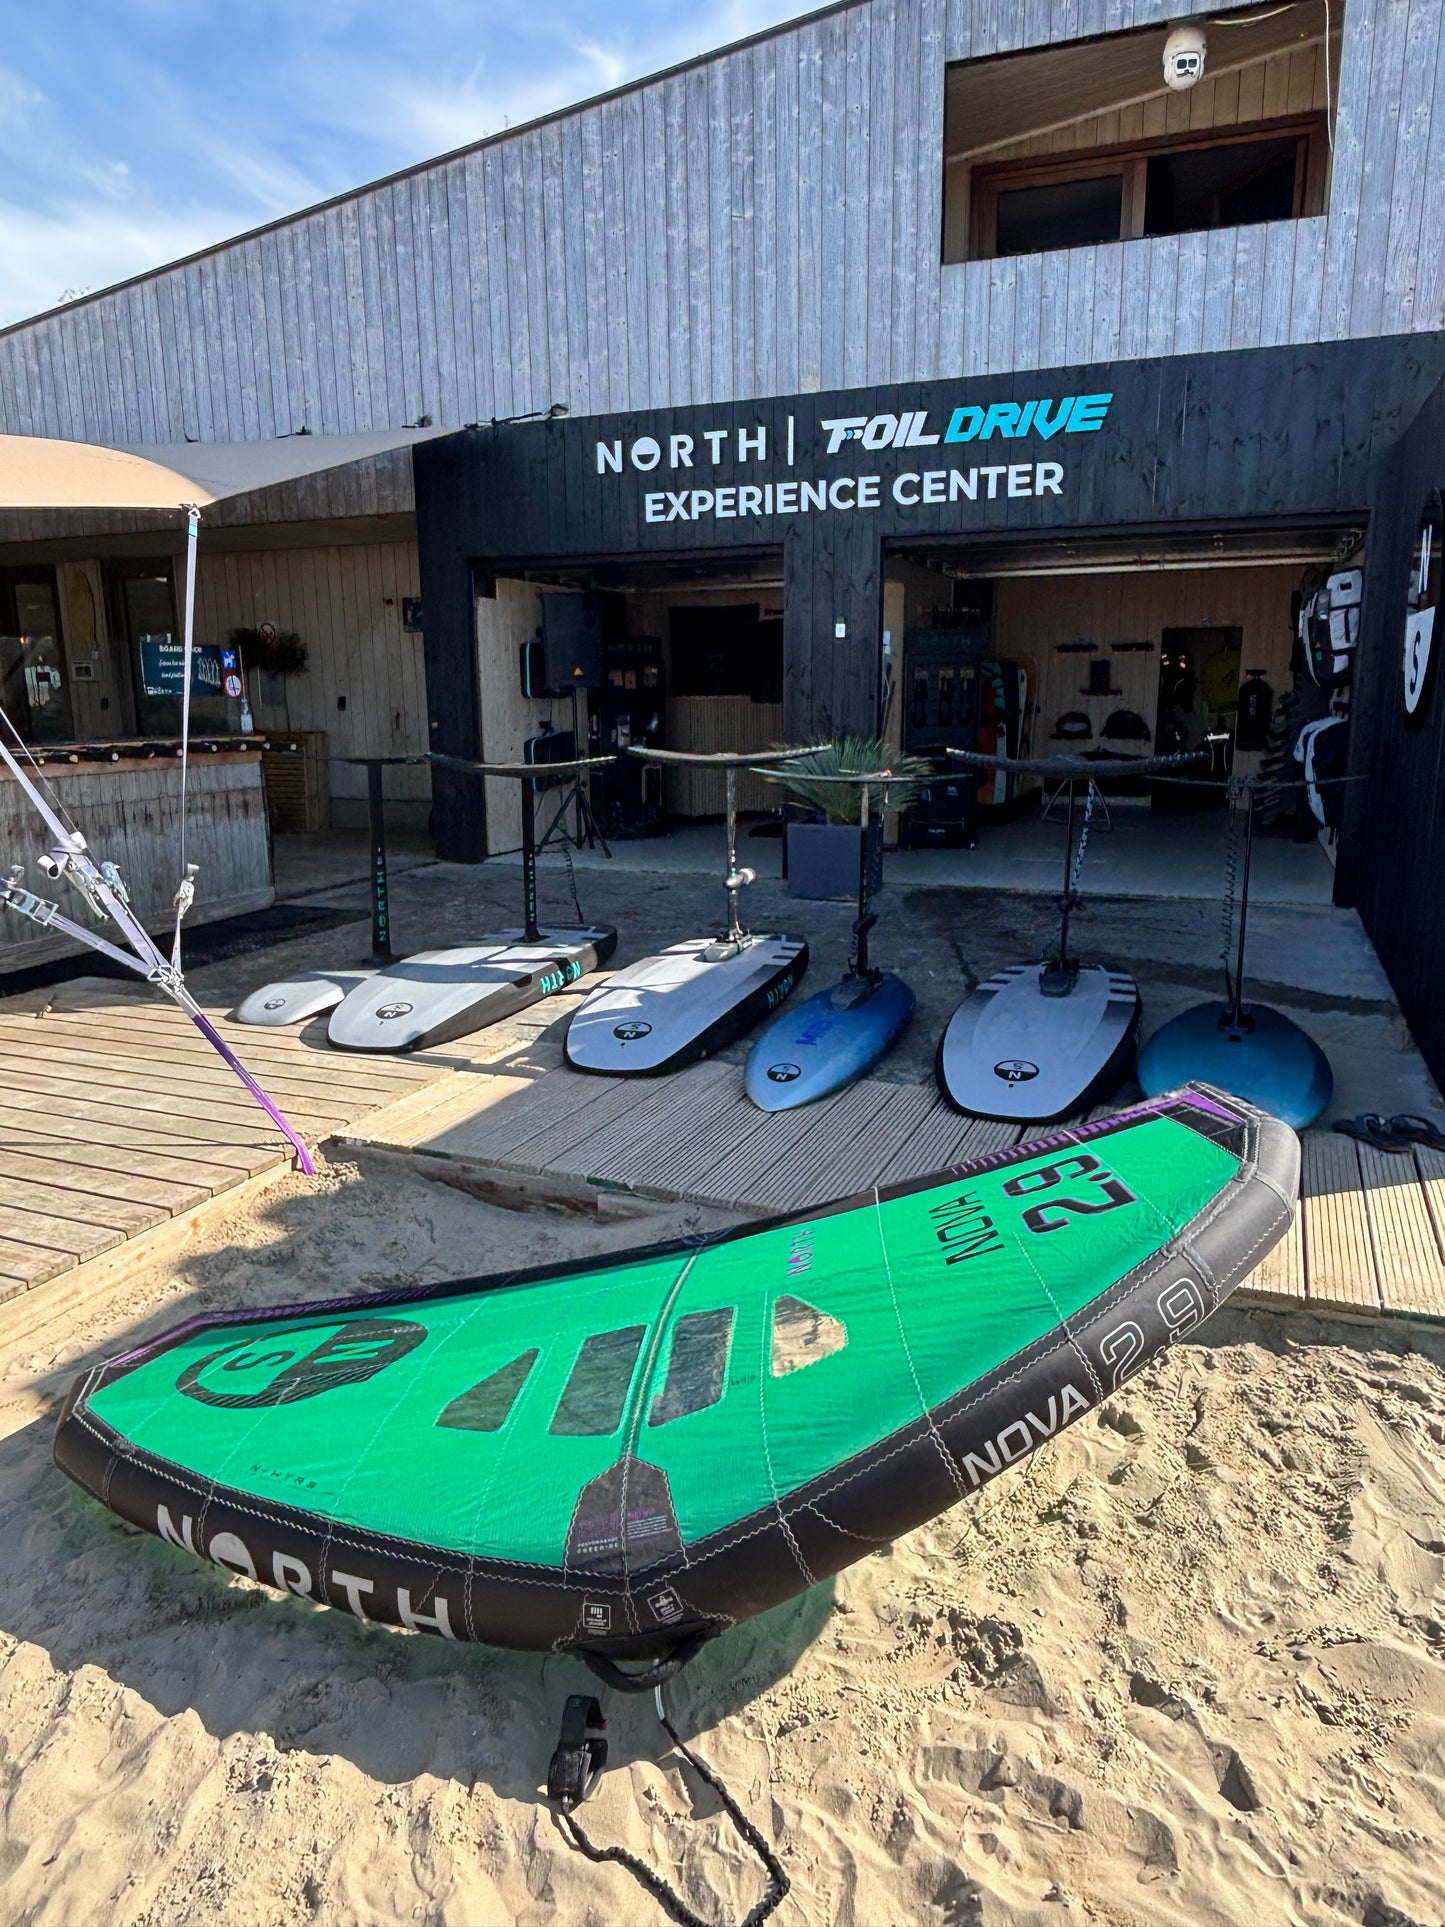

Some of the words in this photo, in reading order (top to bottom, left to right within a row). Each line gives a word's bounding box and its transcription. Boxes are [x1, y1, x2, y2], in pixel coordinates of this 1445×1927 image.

[596, 427, 767, 475] NORTH
[944, 393, 1113, 444] DRIVE
[645, 475, 881, 523] EXPERIENCE
[893, 462, 1064, 506] CENTER
[376, 871, 385, 942] NORTH
[540, 960, 581, 993] NORTH
[928, 1191, 1004, 1266] NOVA
[1001, 1153, 1138, 1234] 2.9
[962, 1384, 1090, 1486] NOVA
[156, 1504, 457, 1640] NORTH
